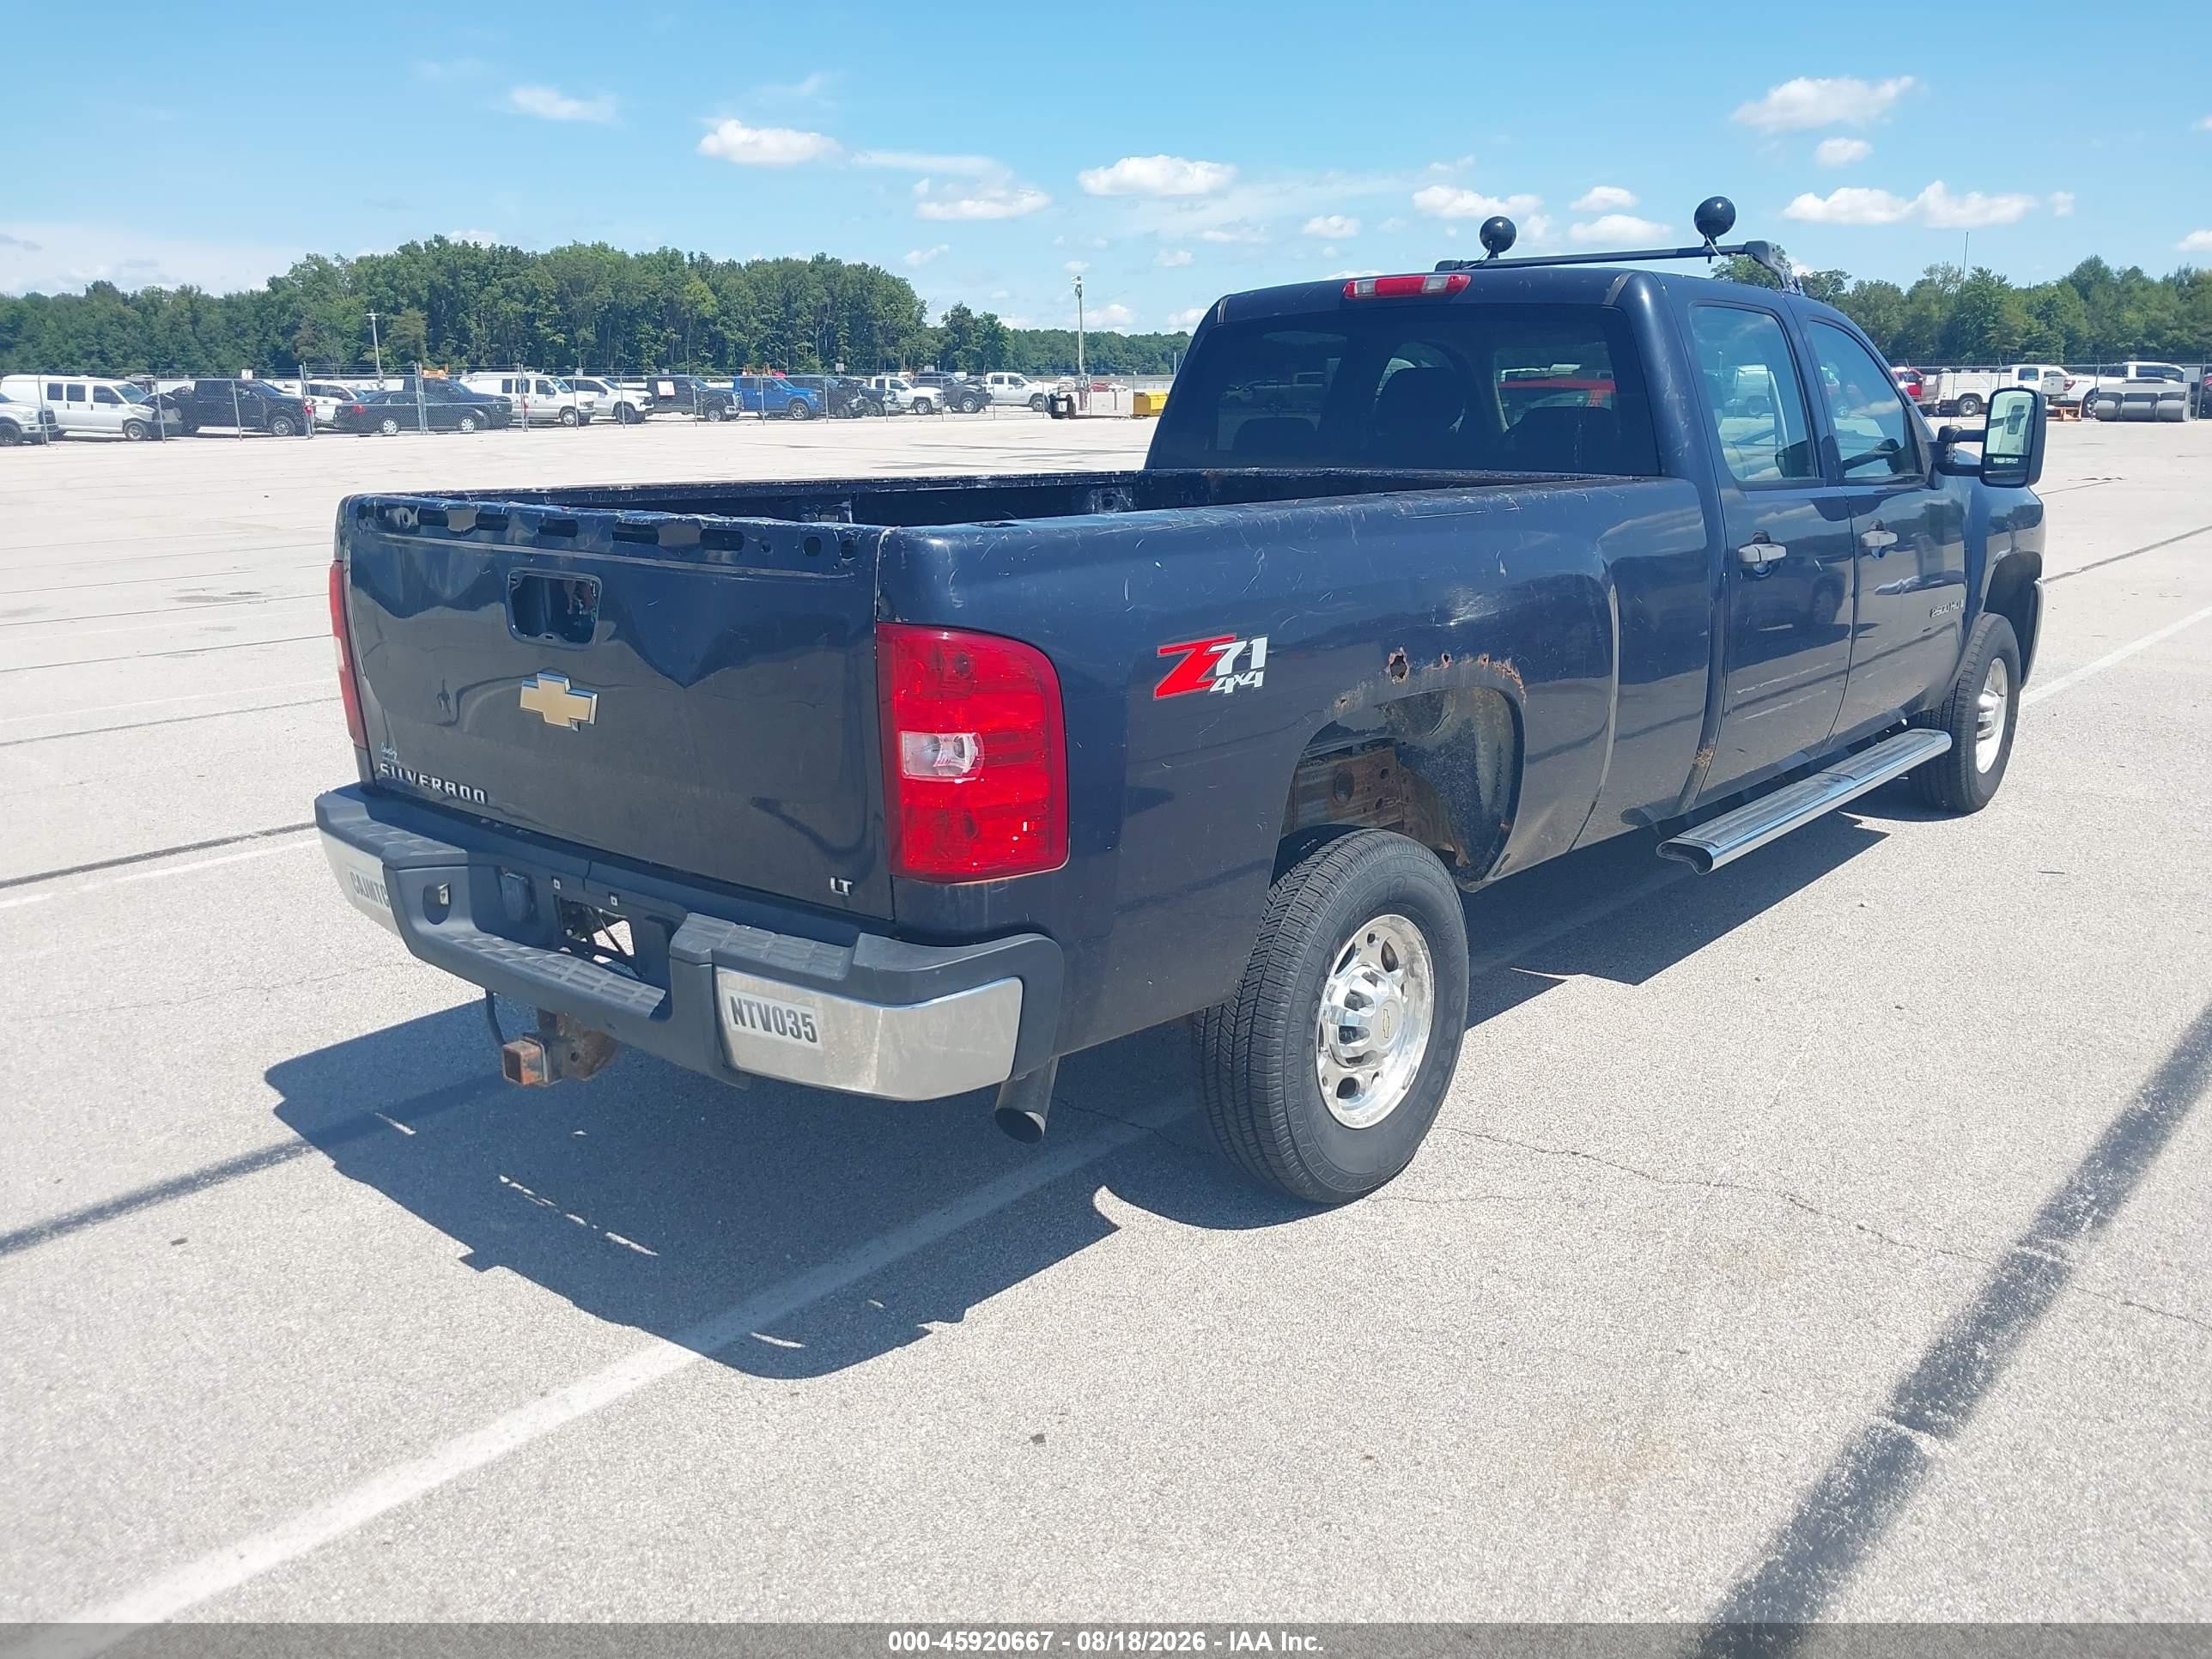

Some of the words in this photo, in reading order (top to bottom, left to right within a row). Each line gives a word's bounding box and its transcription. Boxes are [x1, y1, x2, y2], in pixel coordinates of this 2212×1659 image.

[1153, 633, 1268, 701] Z71
[380, 763, 486, 805] SILVERADO
[830, 877, 853, 896] LT
[729, 994, 817, 1043] NTV035
